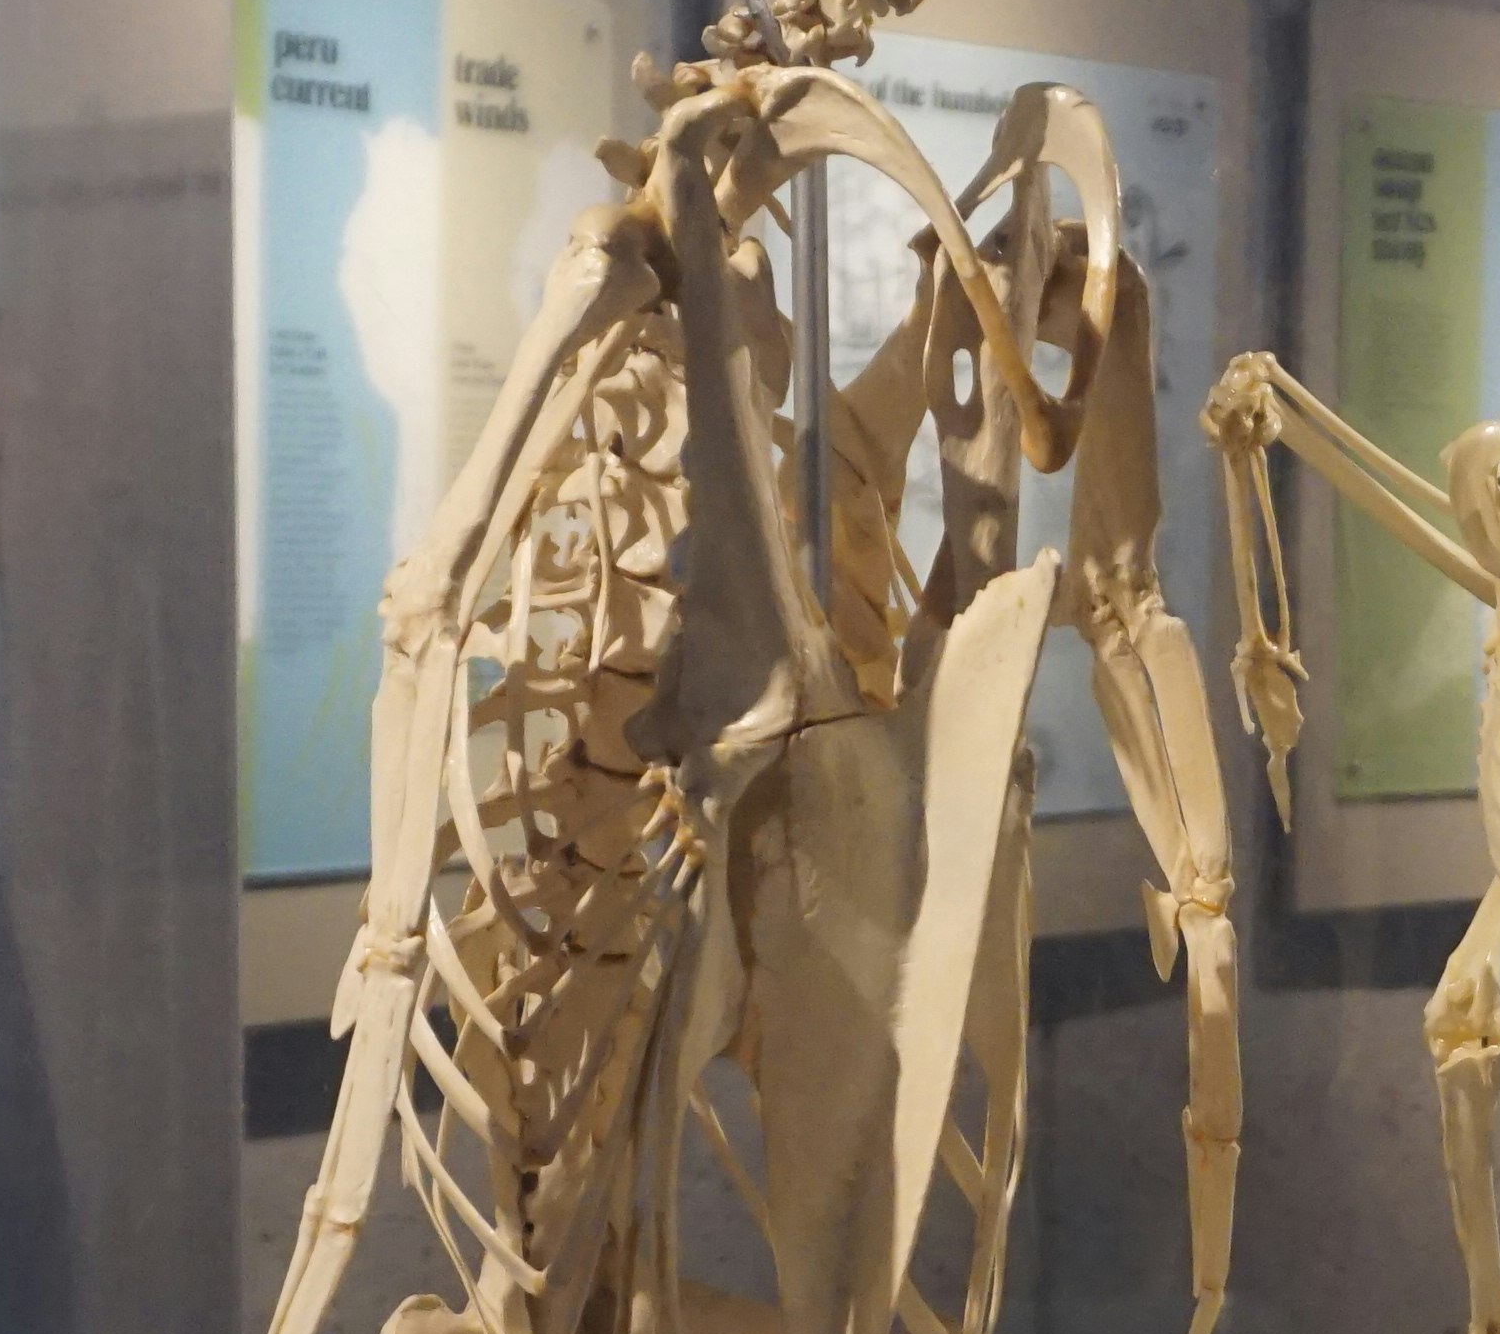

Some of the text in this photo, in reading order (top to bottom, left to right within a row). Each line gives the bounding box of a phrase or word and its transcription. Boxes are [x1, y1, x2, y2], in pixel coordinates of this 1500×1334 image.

[275, 29, 339, 68] peru
[455, 52, 519, 90] trade
[271, 74, 371, 112] current
[455, 94, 529, 132] winds
